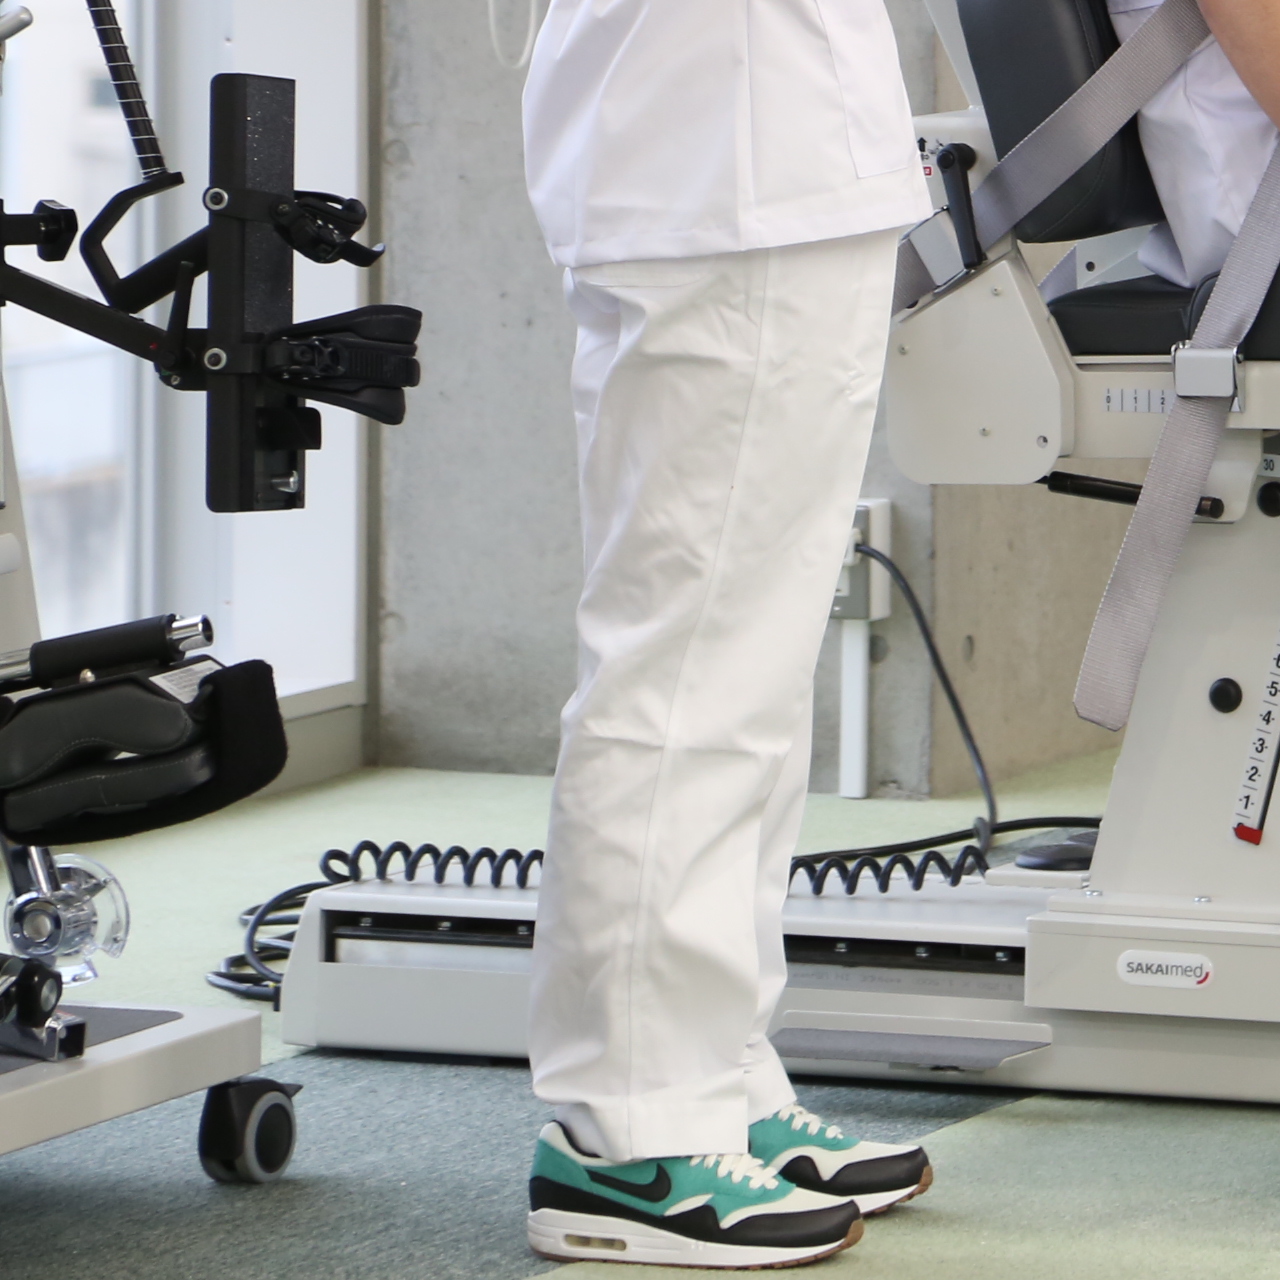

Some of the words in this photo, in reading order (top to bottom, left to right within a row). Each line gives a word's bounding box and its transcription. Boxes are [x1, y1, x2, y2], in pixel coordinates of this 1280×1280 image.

[1105, 395, 1112, 404] 0
[1133, 396, 1138, 404] 1
[1160, 397, 1166, 405] 2
[1263, 459, 1275, 471] 30
[1268, 680, 1279, 697] 5
[1262, 709, 1272, 726] 4
[1254, 737, 1265, 754] 3
[1247, 765, 1259, 782] 2
[1242, 794, 1251, 810] 1
[1126, 961, 1204, 978] SAKAImed
